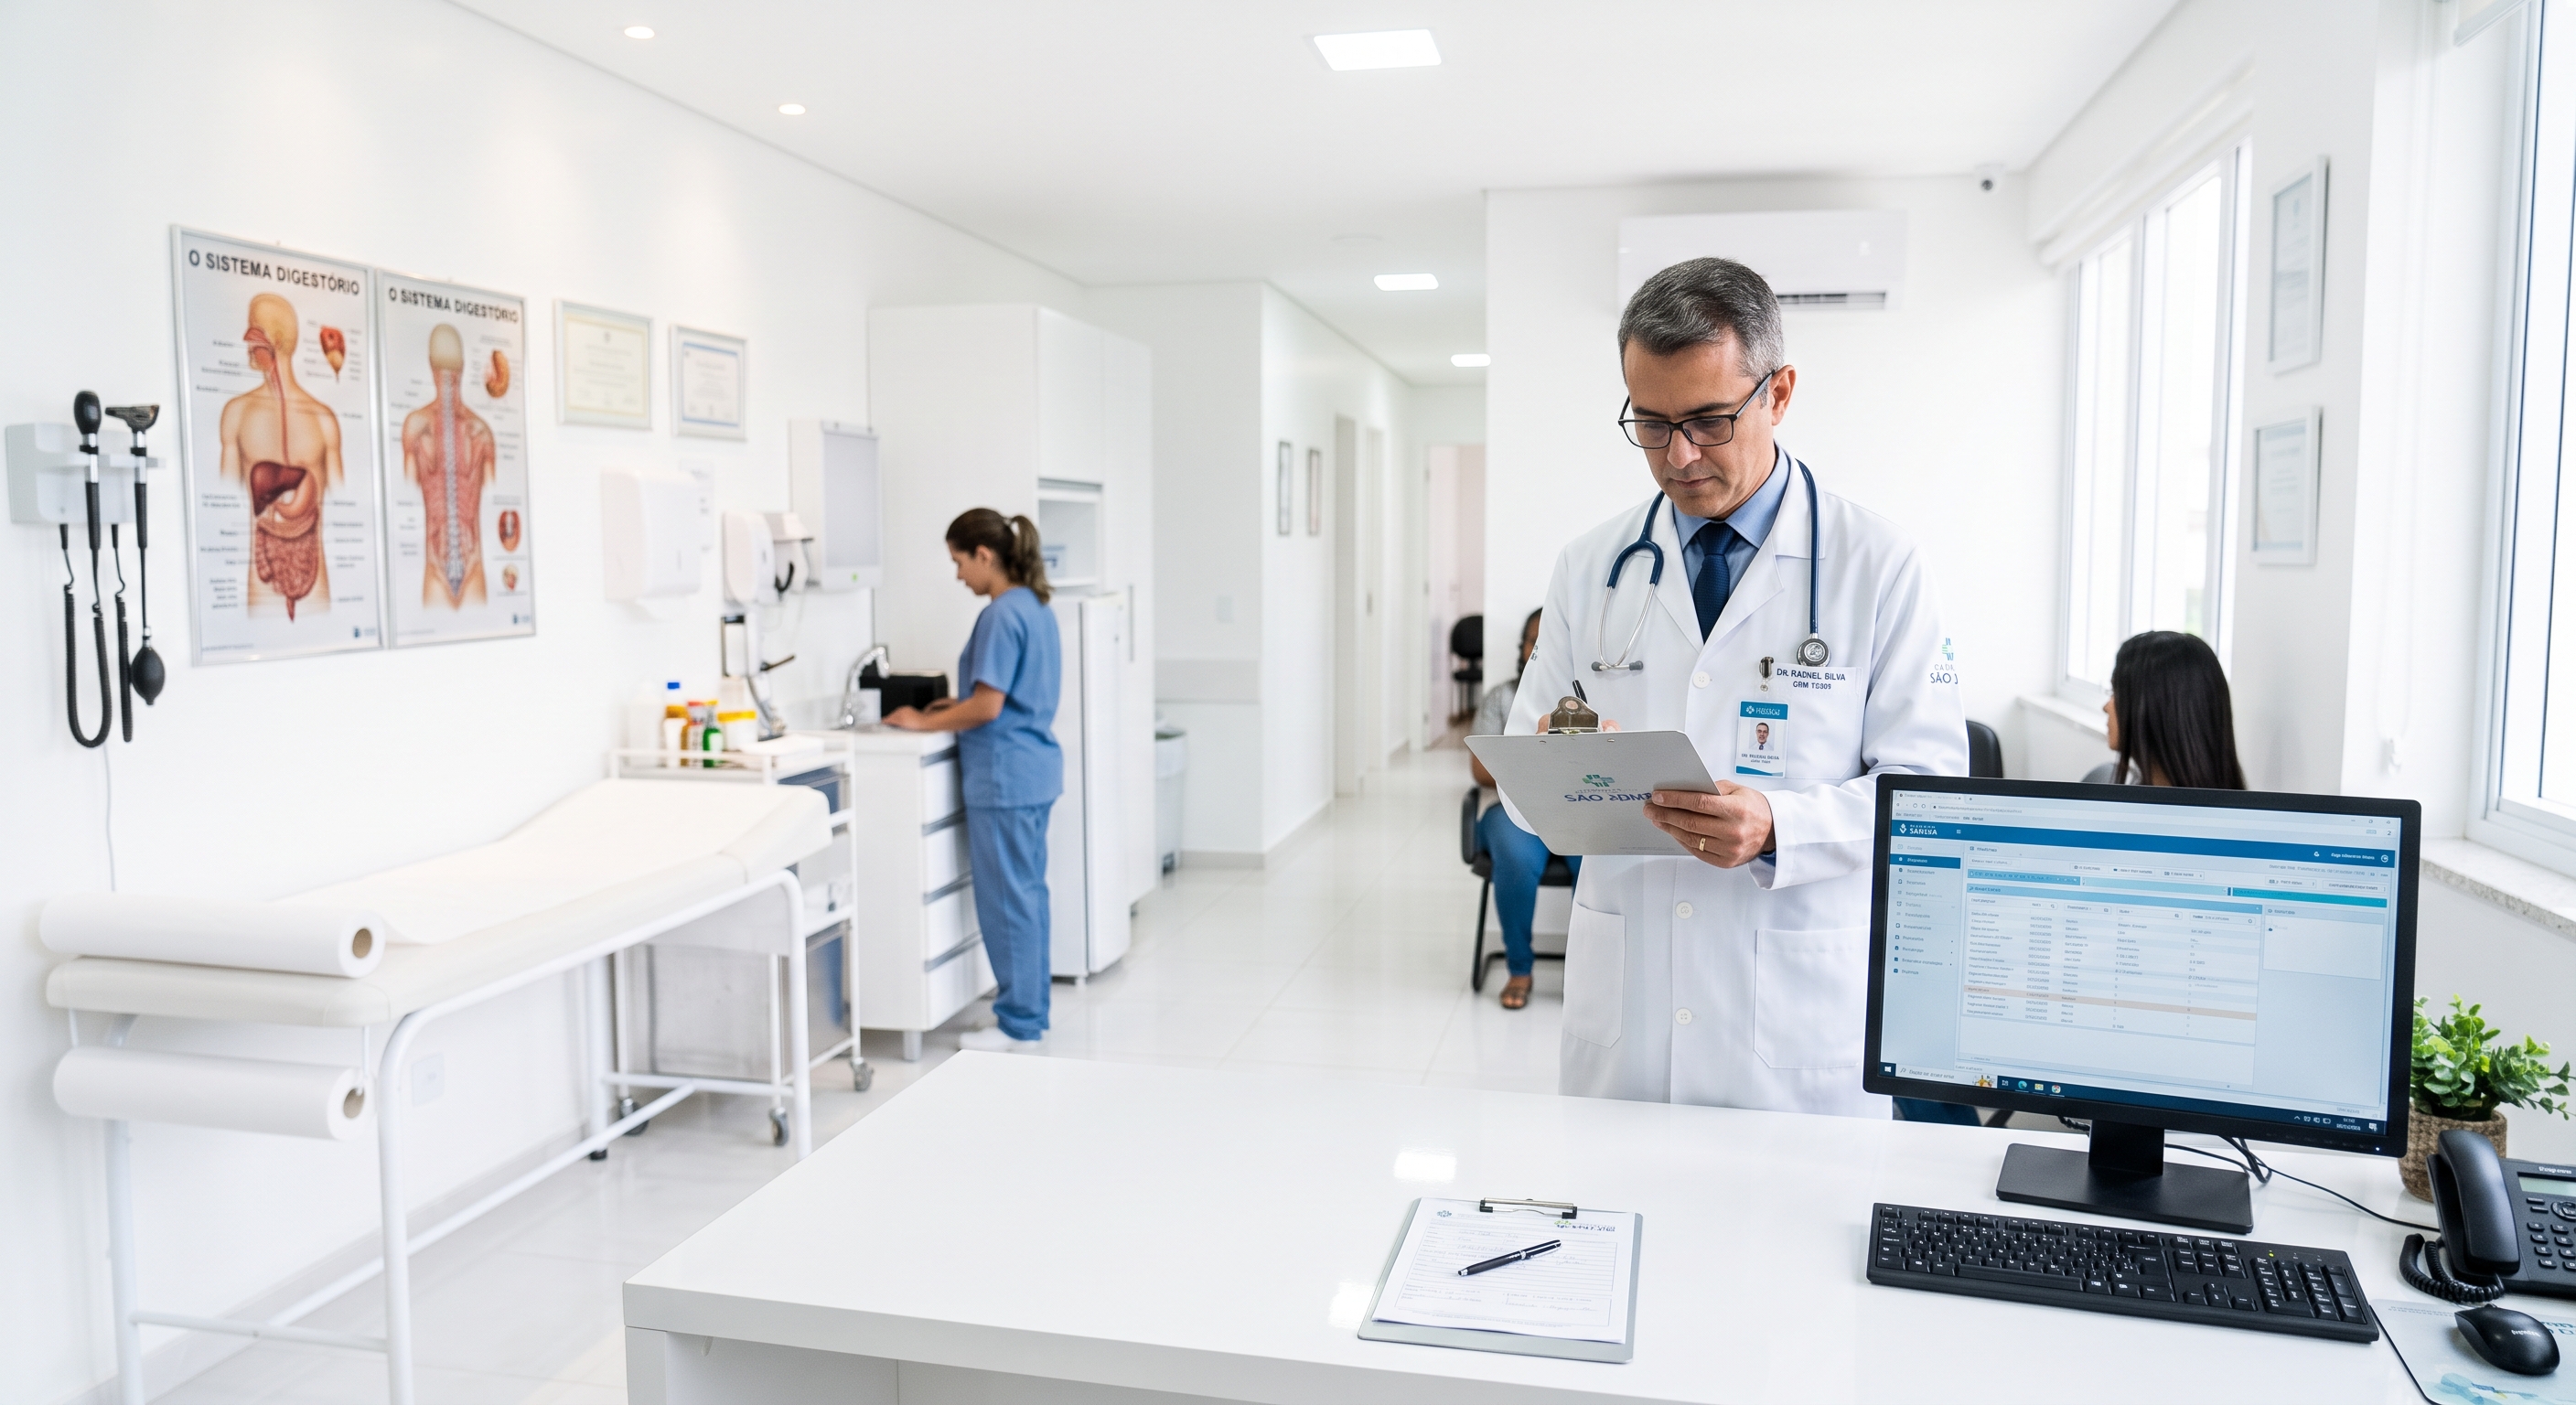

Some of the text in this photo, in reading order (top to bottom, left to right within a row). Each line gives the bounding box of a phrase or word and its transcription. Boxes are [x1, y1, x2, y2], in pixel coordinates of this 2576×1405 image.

[188, 250, 360, 296] O SISTEMA DIGESTÓRIO
[389, 287, 397, 301] O
[401, 288, 452, 312] SISTEMA
[1776, 668, 1788, 677] DR.
